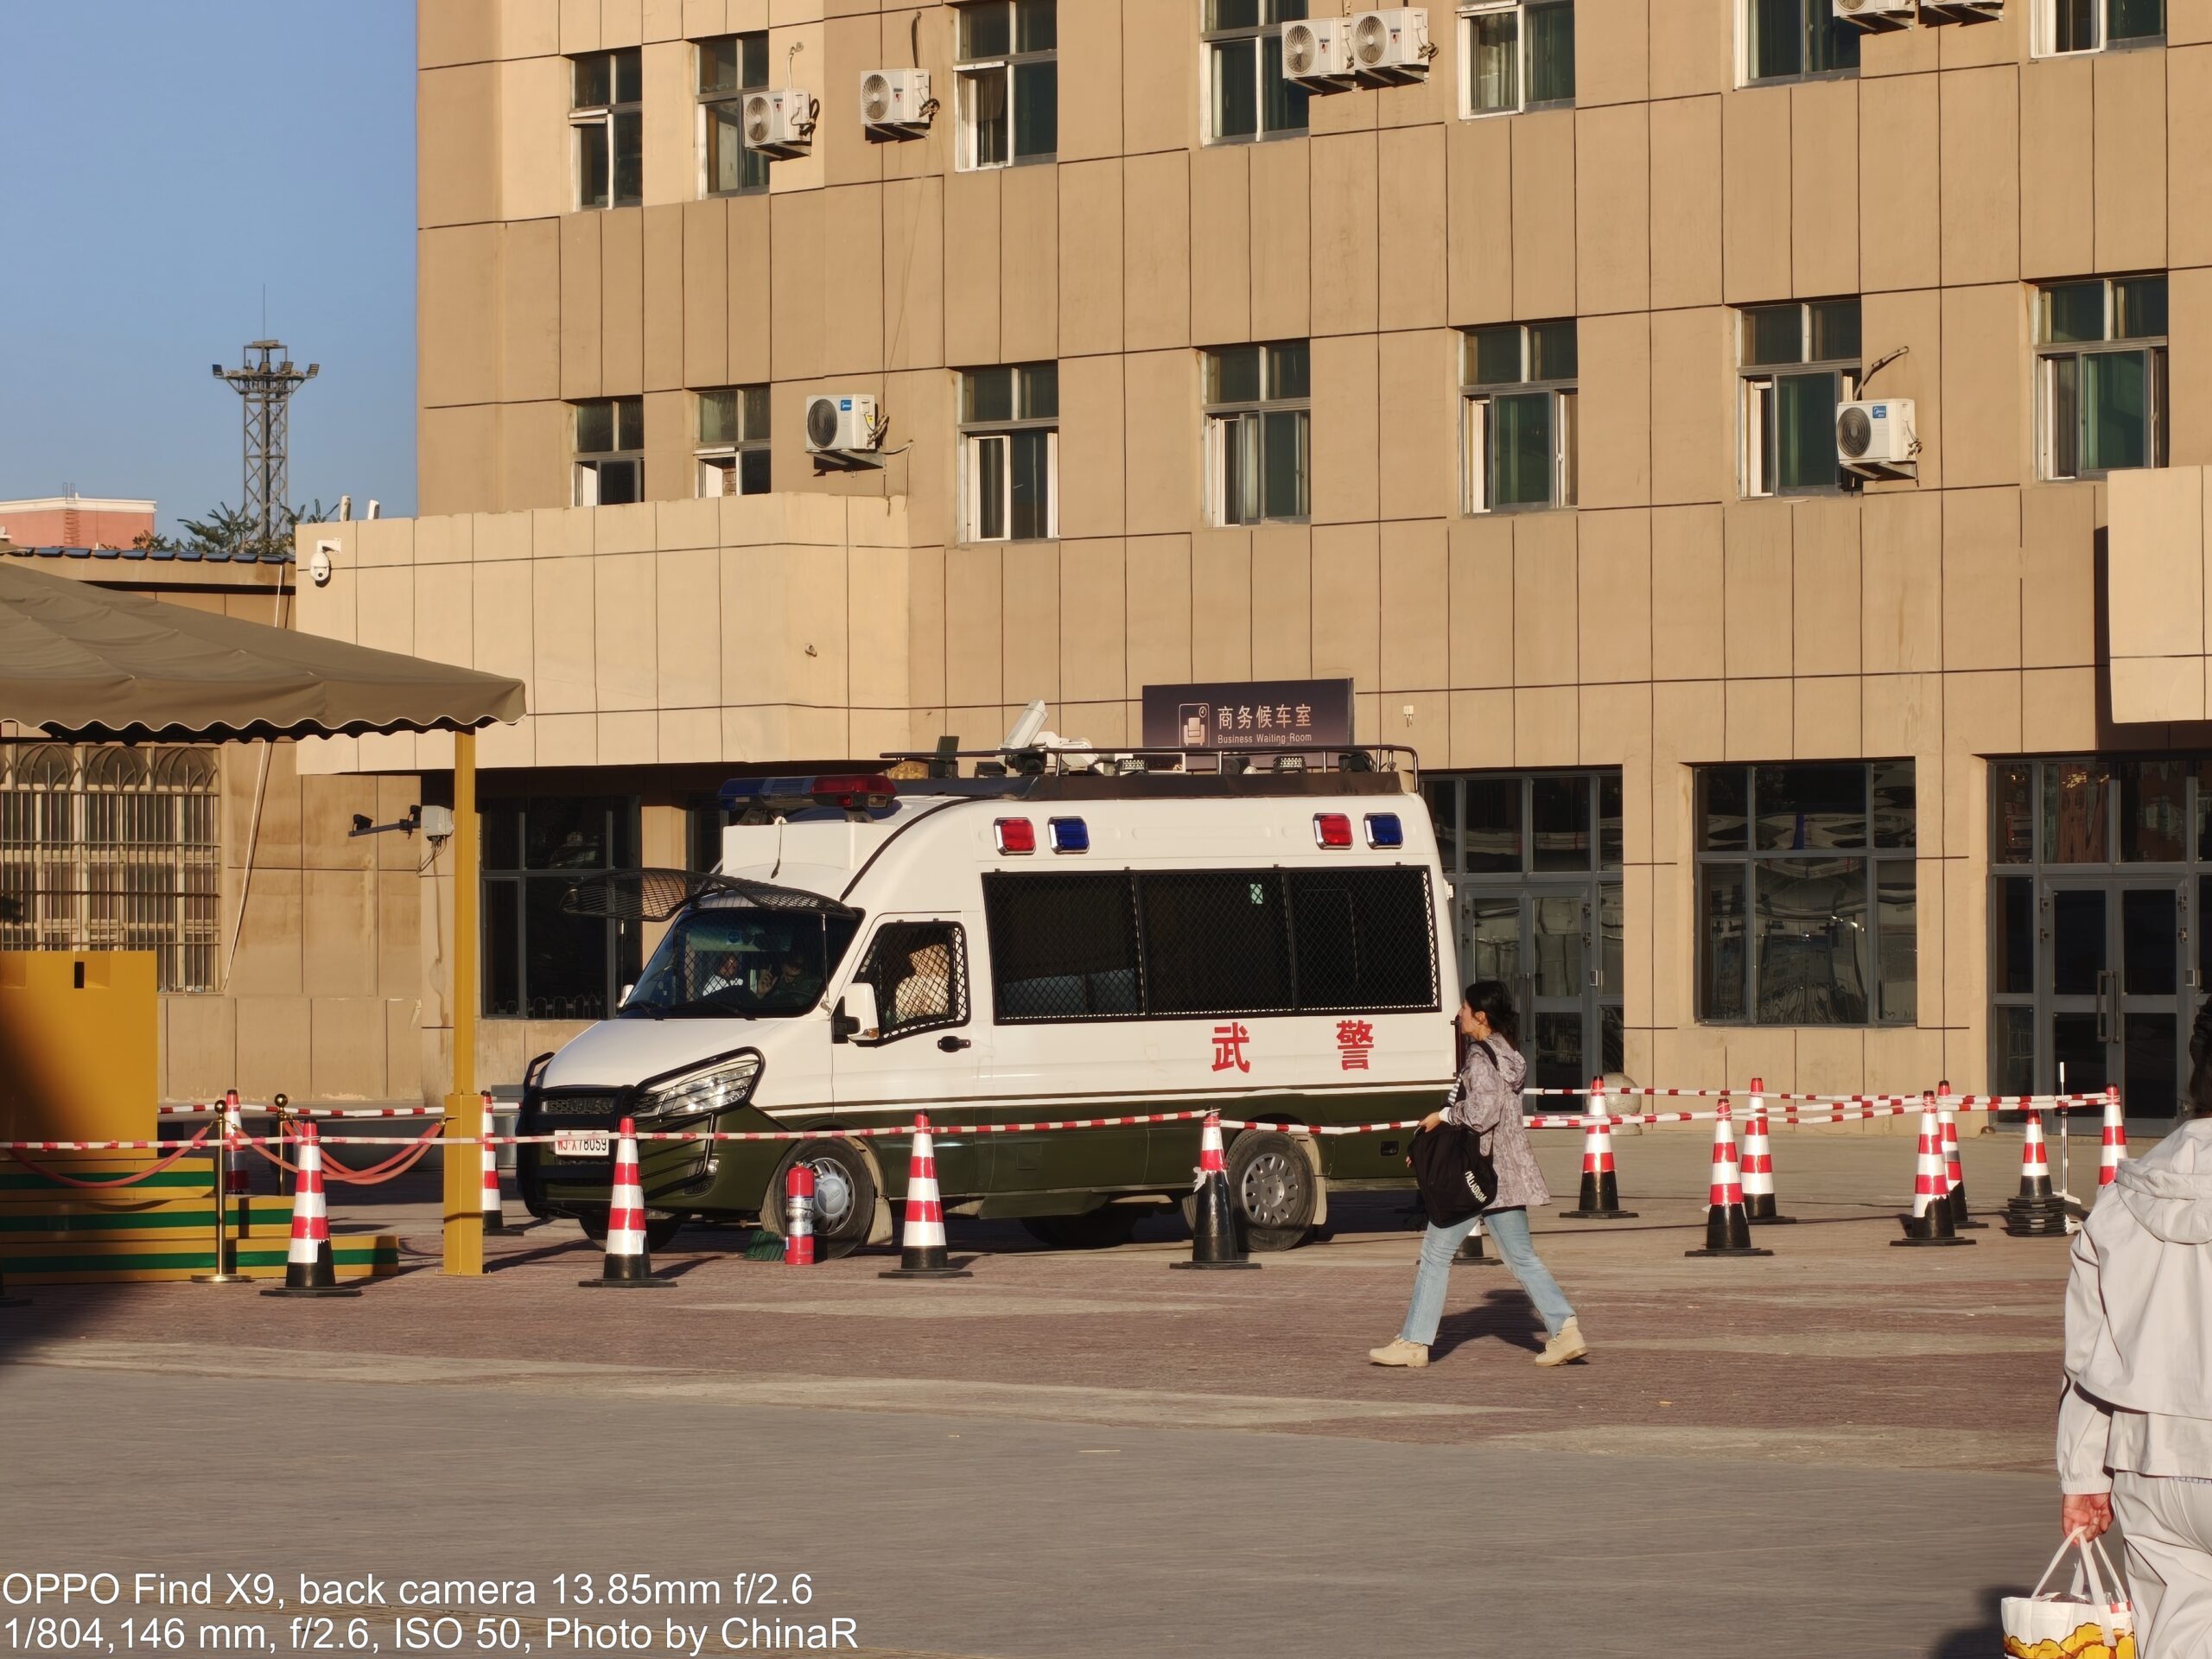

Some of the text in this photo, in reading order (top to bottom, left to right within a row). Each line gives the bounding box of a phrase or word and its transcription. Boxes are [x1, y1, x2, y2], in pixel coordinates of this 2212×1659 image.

[1217, 703, 1312, 729] 商务候车室
[1217, 733, 1312, 745] Business Waiting Room
